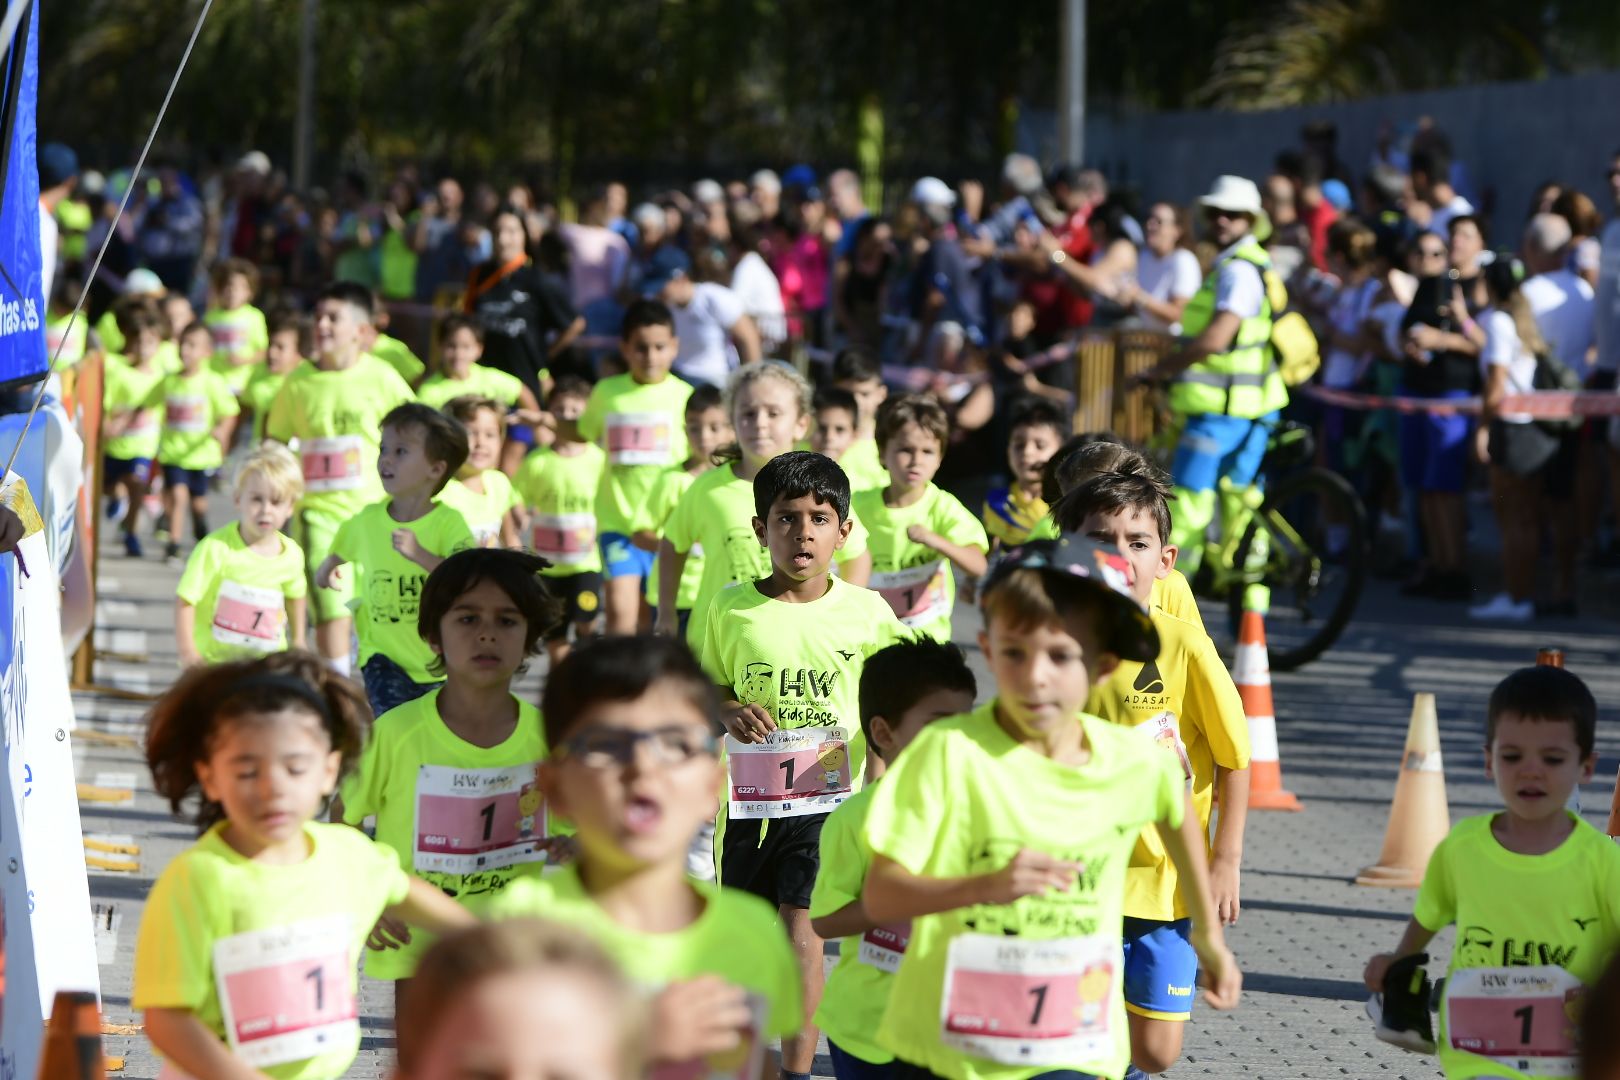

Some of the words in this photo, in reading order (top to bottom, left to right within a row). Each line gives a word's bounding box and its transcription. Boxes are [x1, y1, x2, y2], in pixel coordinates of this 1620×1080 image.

[323, 455, 330, 473] 1
[902, 590, 913, 611] 1
[253, 610, 264, 630] 1
[780, 668, 841, 698] HW
[1124, 695, 1171, 704] ADASAT
[778, 707, 803, 722] Kids
[805, 707, 832, 723] Race
[780, 757, 795, 790] 1
[480, 801, 496, 841] 1
[1503, 938, 1577, 969] HW
[306, 966, 323, 1011] 1
[1028, 983, 1049, 1026] 1
[1513, 1004, 1534, 1045] 1
